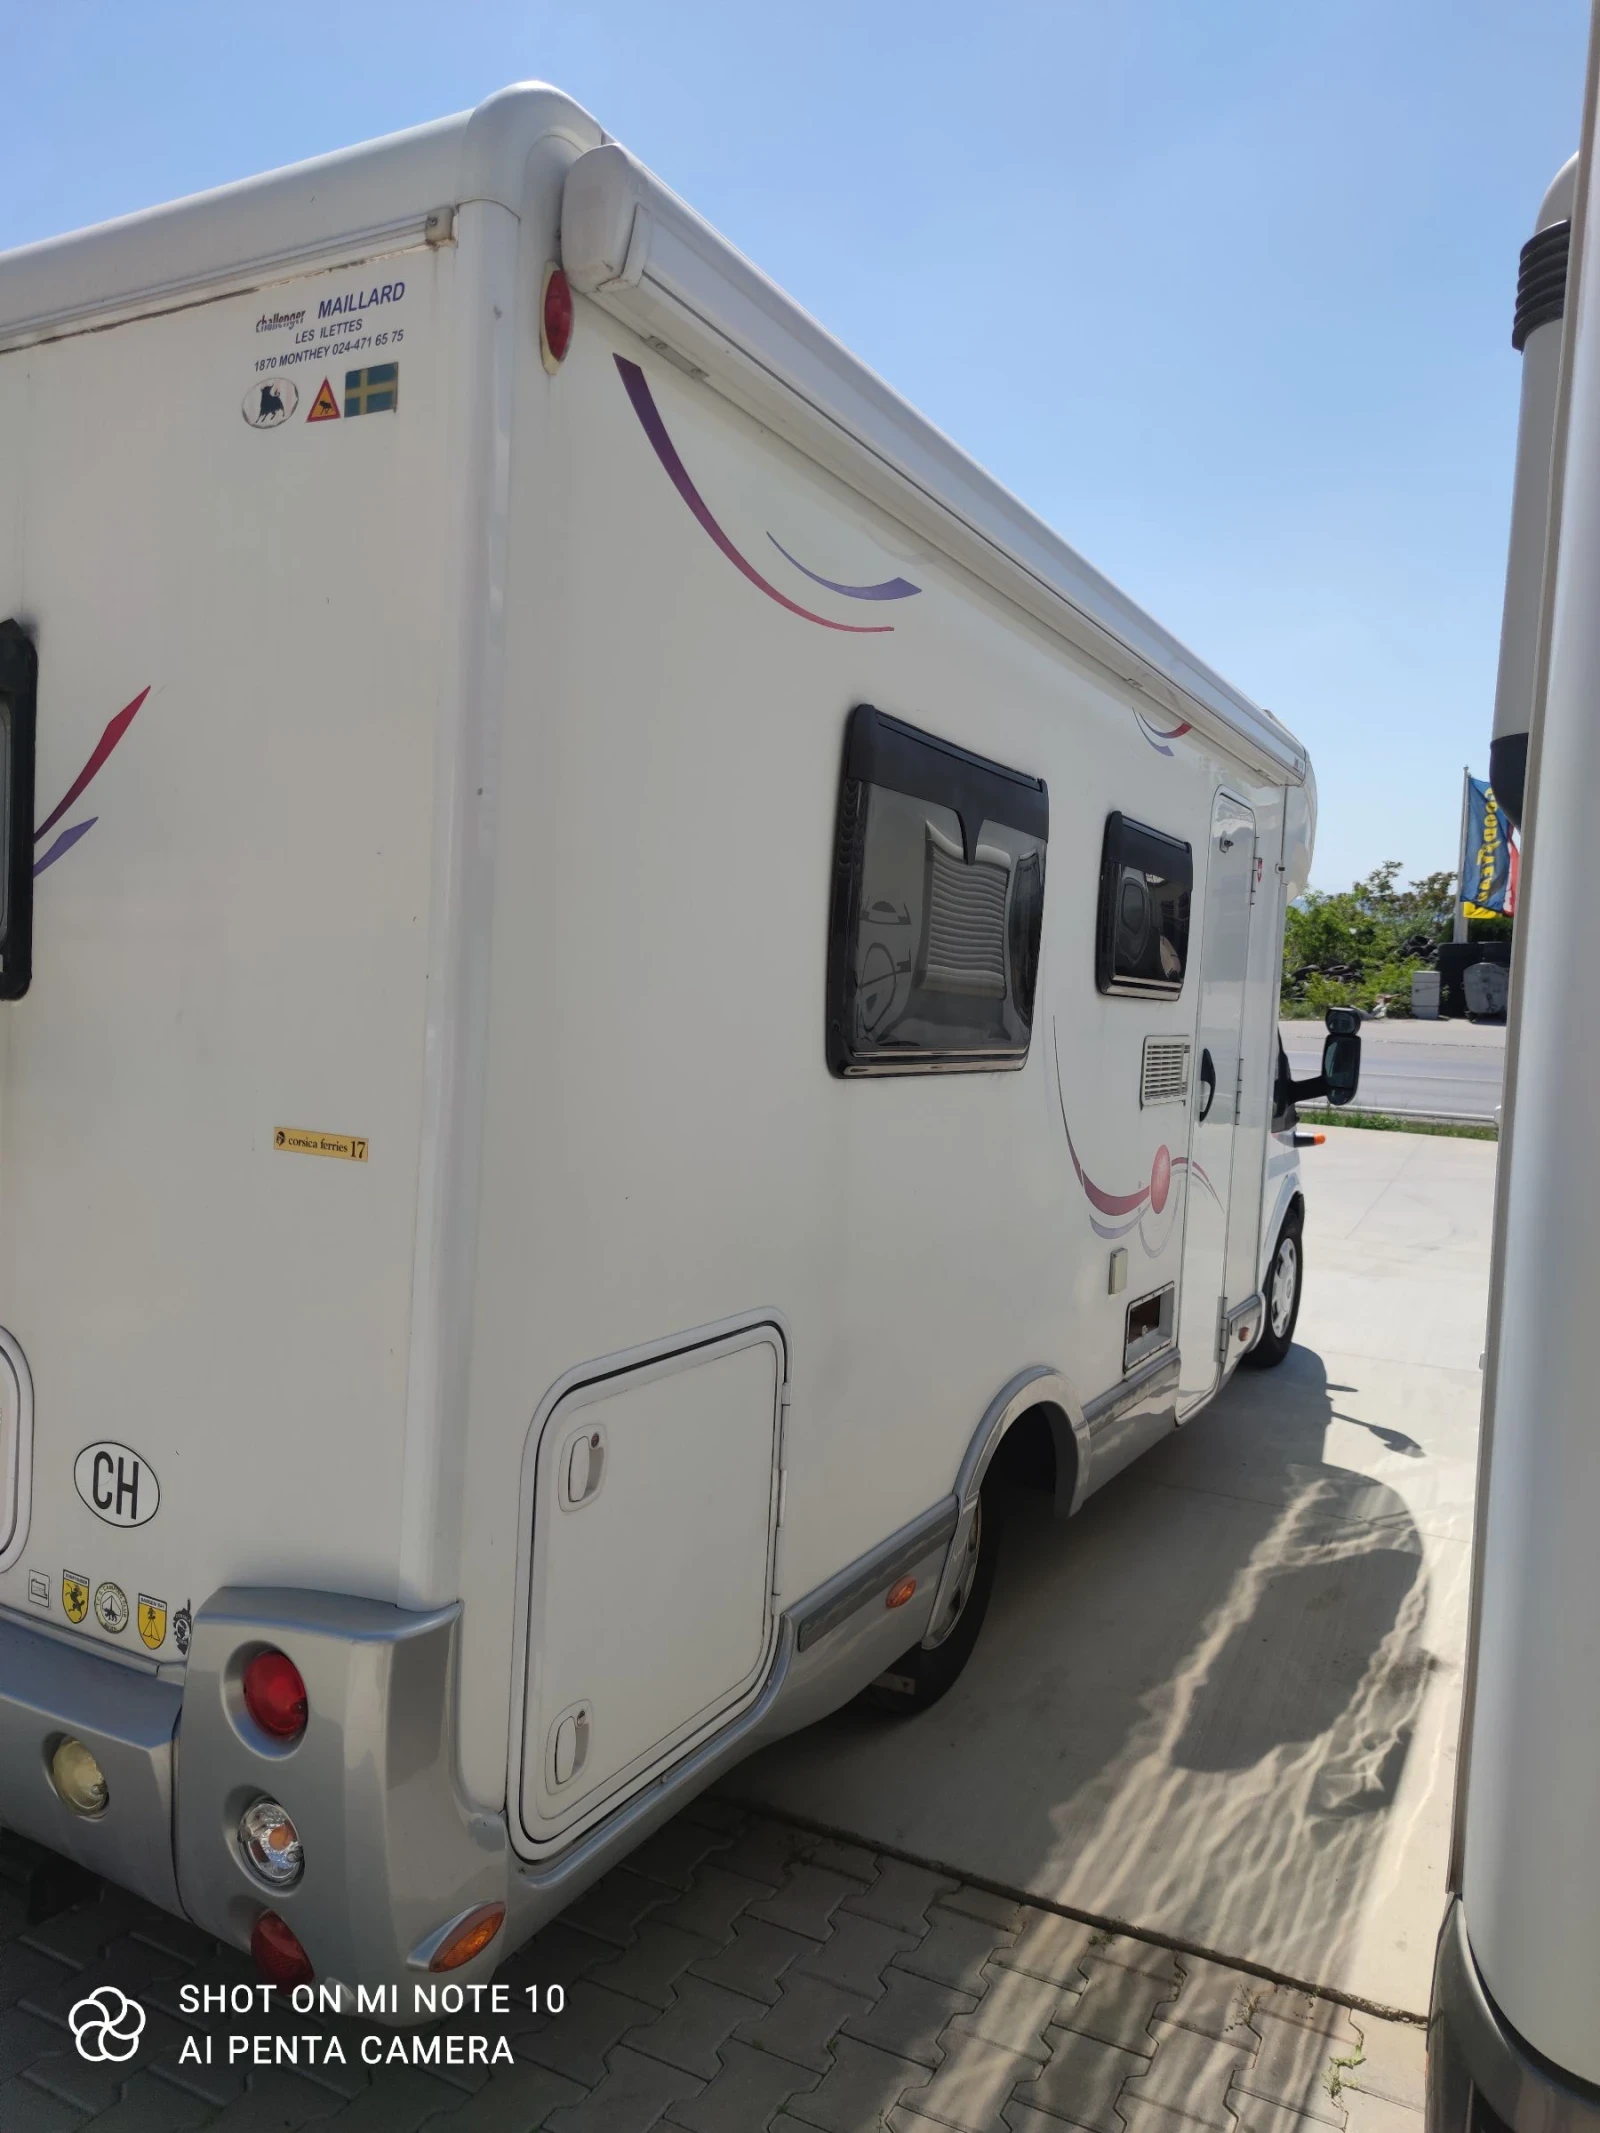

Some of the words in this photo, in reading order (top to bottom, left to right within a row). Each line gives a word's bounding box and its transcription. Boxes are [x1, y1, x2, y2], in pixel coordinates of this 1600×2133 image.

[318, 282, 405, 319] MAILLARD
[295, 330, 315, 344] LES
[320, 319, 363, 339] ILETTES
[254, 356, 277, 372] 1870
[279, 346, 330, 366] MONTHEY
[332, 336, 372, 356] 024-471
[375, 332, 388, 346] 65
[391, 329, 404, 343] 75
[288, 1137, 318, 1149] corsica
[320, 1138, 348, 1153] ferries
[350, 1140, 366, 1159] 17
[93, 1451, 139, 1519] CH
